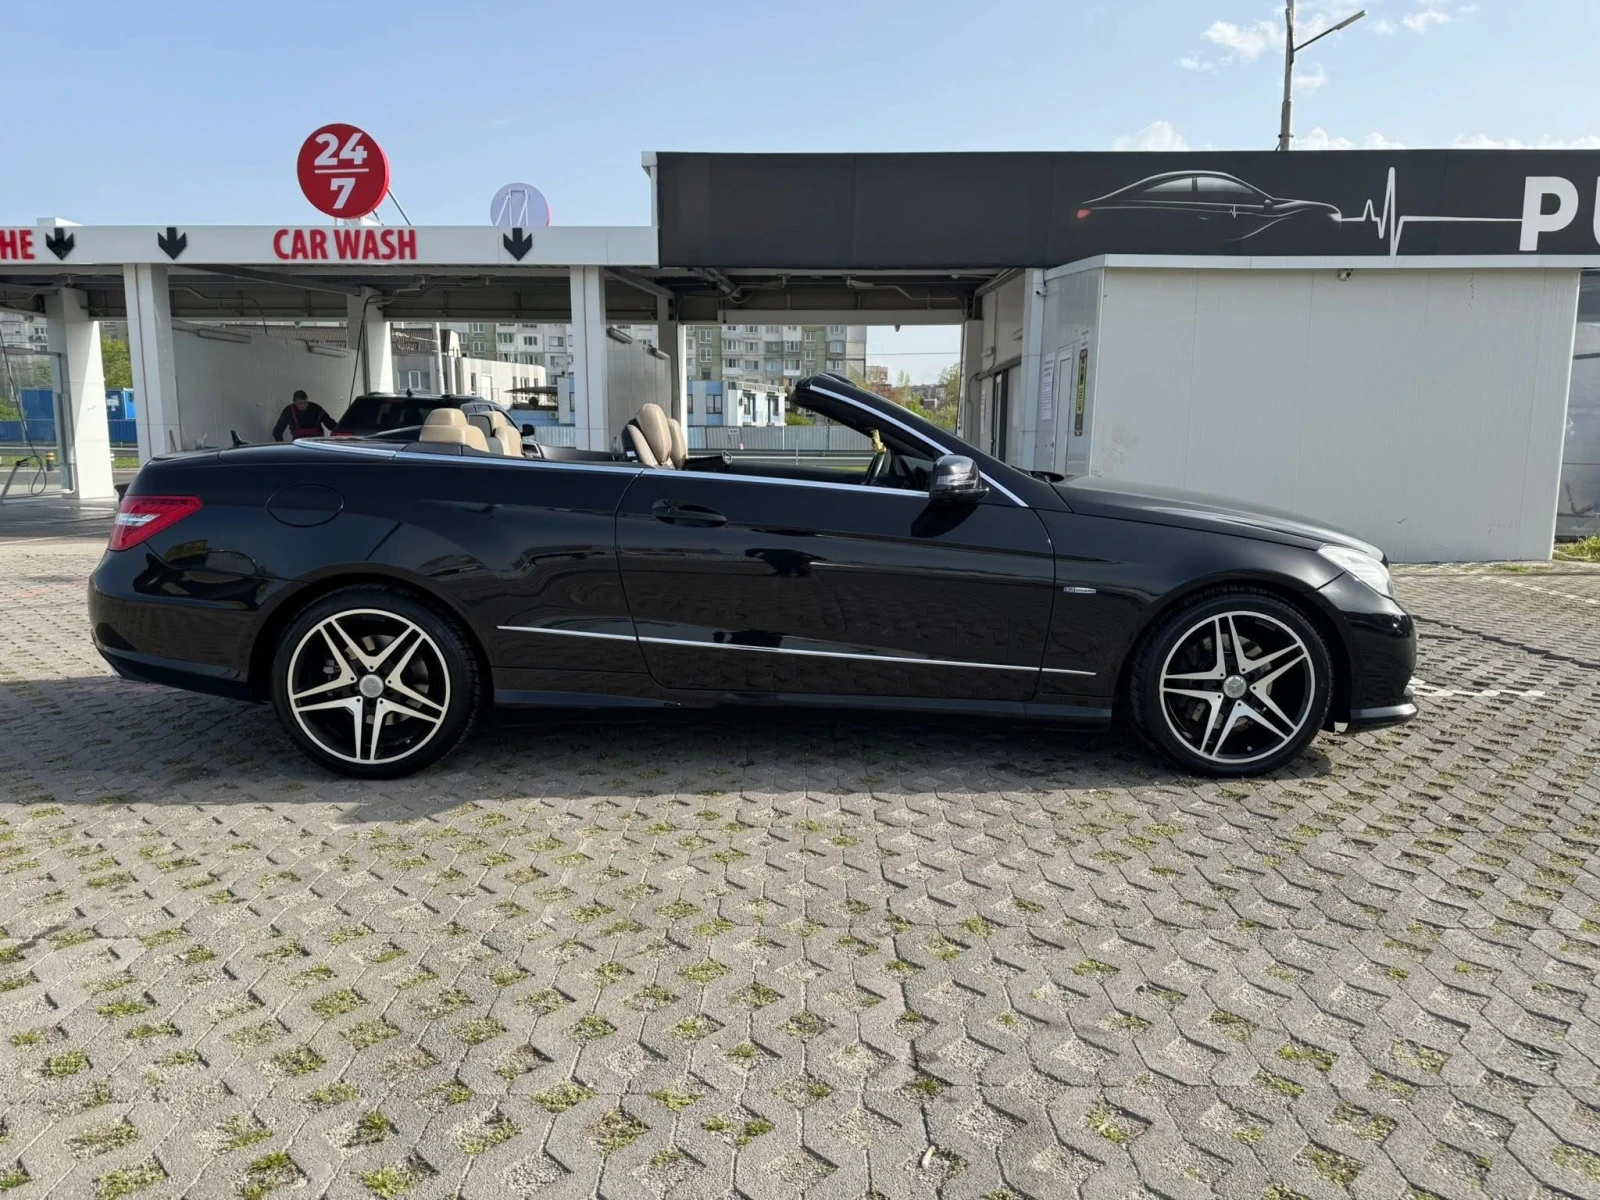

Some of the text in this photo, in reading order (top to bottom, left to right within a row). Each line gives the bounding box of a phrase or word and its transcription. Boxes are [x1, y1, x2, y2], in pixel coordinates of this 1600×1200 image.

[314, 132, 368, 166] 24
[330, 177, 356, 209] 7
[1519, 176, 1600, 251] P
[0, 230, 35, 260] HE
[273, 229, 417, 260] CAR WASH
